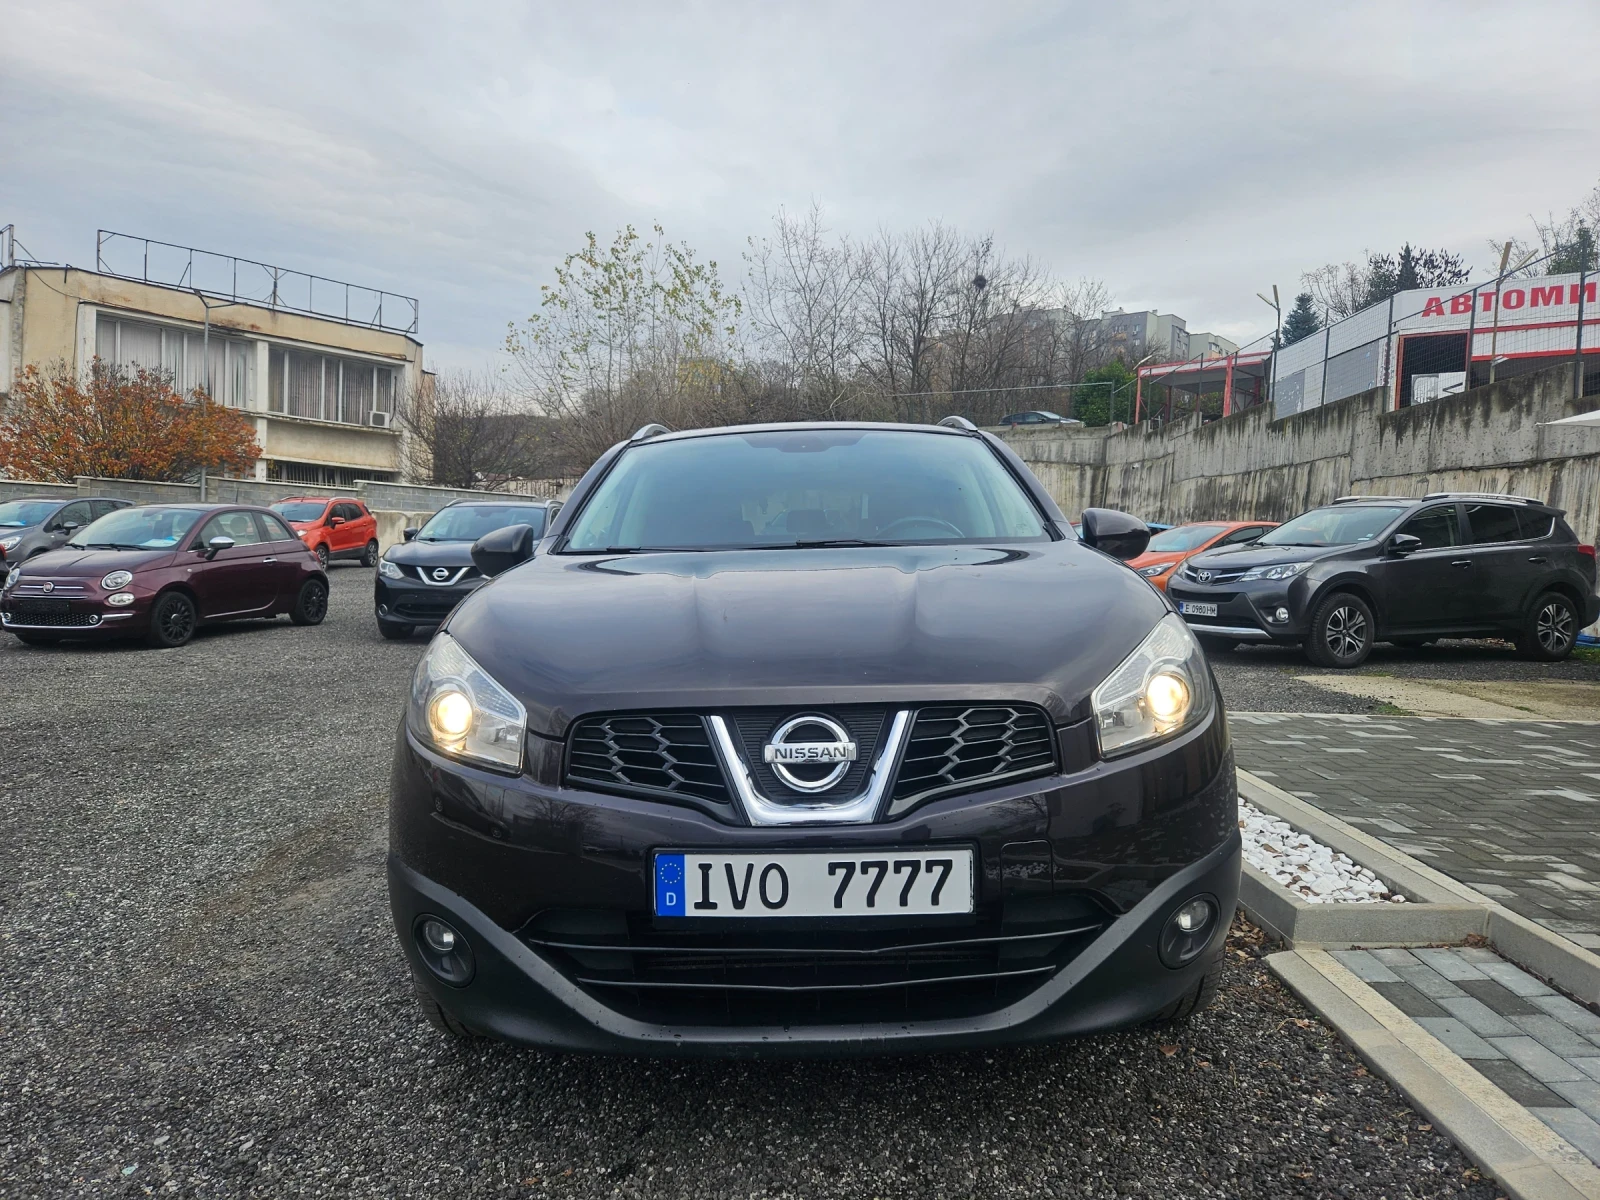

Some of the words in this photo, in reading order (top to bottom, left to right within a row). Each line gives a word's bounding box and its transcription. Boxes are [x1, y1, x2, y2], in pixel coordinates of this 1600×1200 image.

[774, 746, 848, 759] NISSAN
[693, 863, 789, 910] IVO
[828, 859, 953, 908] 7777
[665, 892, 676, 906] D
